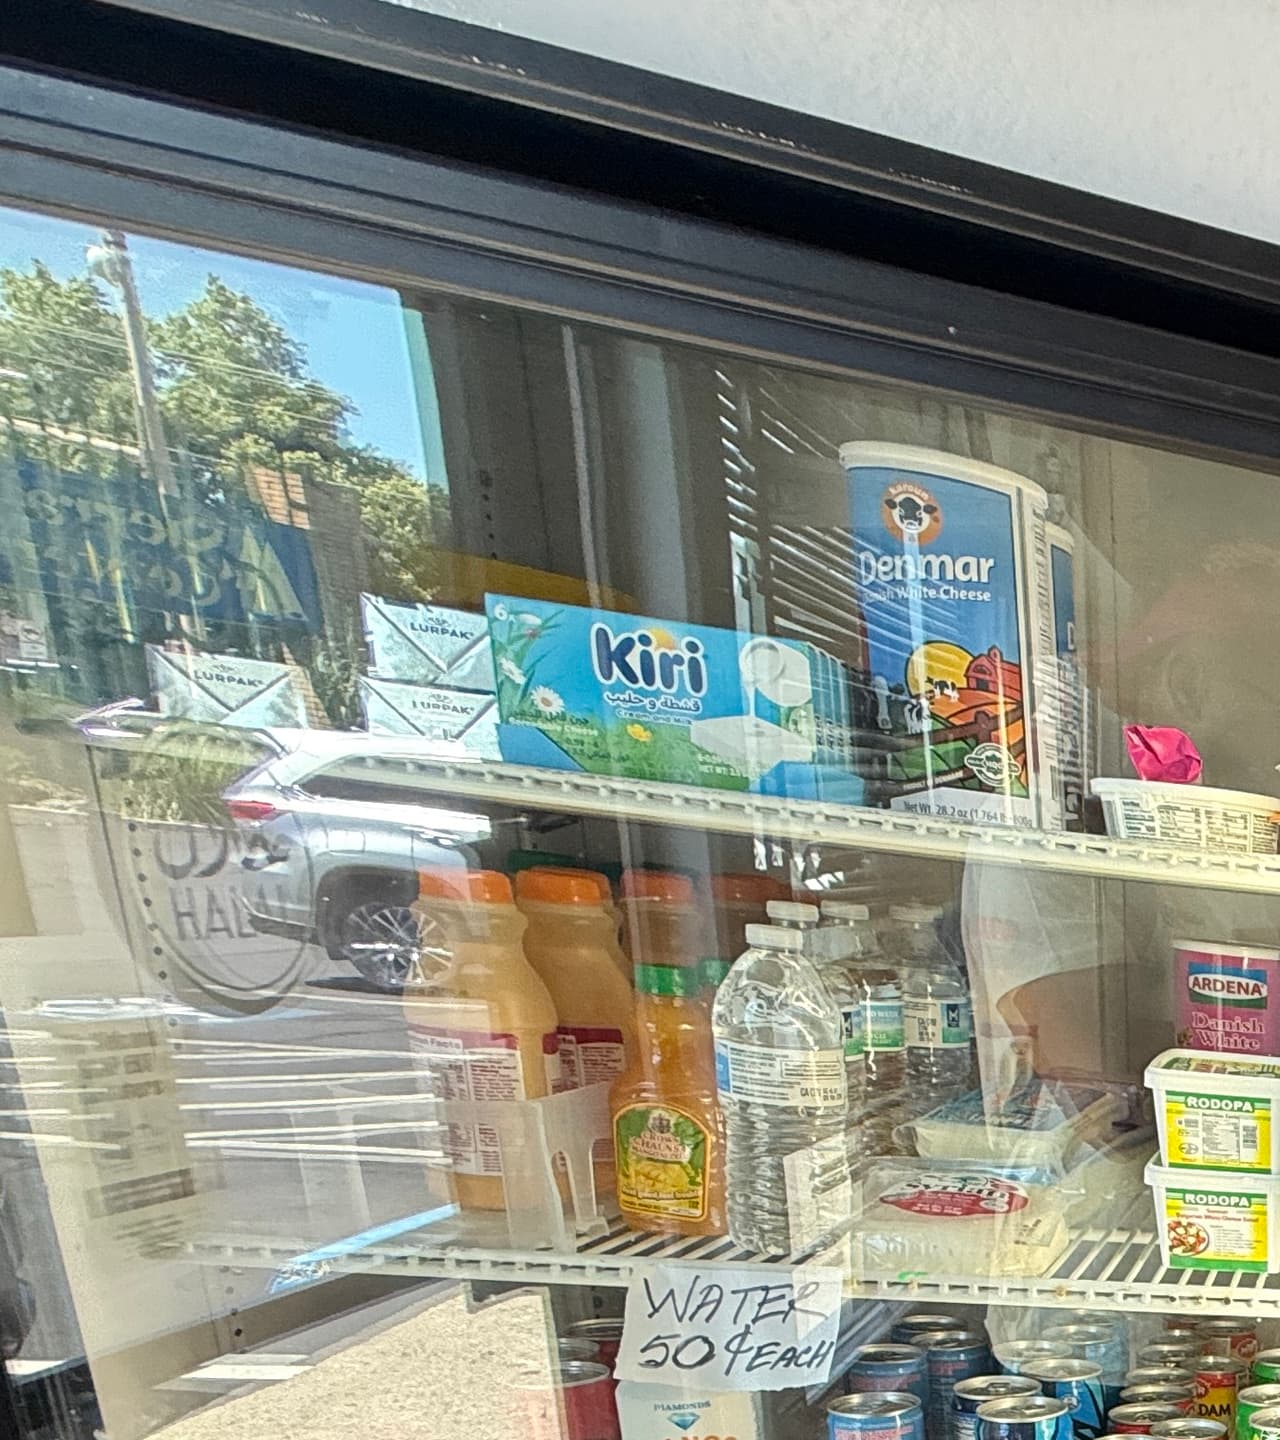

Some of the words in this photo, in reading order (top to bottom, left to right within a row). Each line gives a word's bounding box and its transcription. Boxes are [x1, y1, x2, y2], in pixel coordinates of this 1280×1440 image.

[858, 550, 995, 585] Denmar
[938, 586, 992, 601] Cheese
[494, 604, 508, 620] 6
[410, 622, 473, 641] LURPAK
[592, 624, 706, 695] Kiri
[193, 669, 260, 687] LURPAK
[1192, 977, 1264, 996] ARDENA
[1192, 1012, 1265, 1034] Danish
[1195, 1030, 1260, 1050] White
[1186, 1096, 1254, 1112] RODOPA
[1184, 1193, 1250, 1208] RODOPA
[643, 1275, 828, 1325] WATER
[745, 1340, 836, 1373] EACH
[653, 1400, 712, 1412] DIAMONDS
